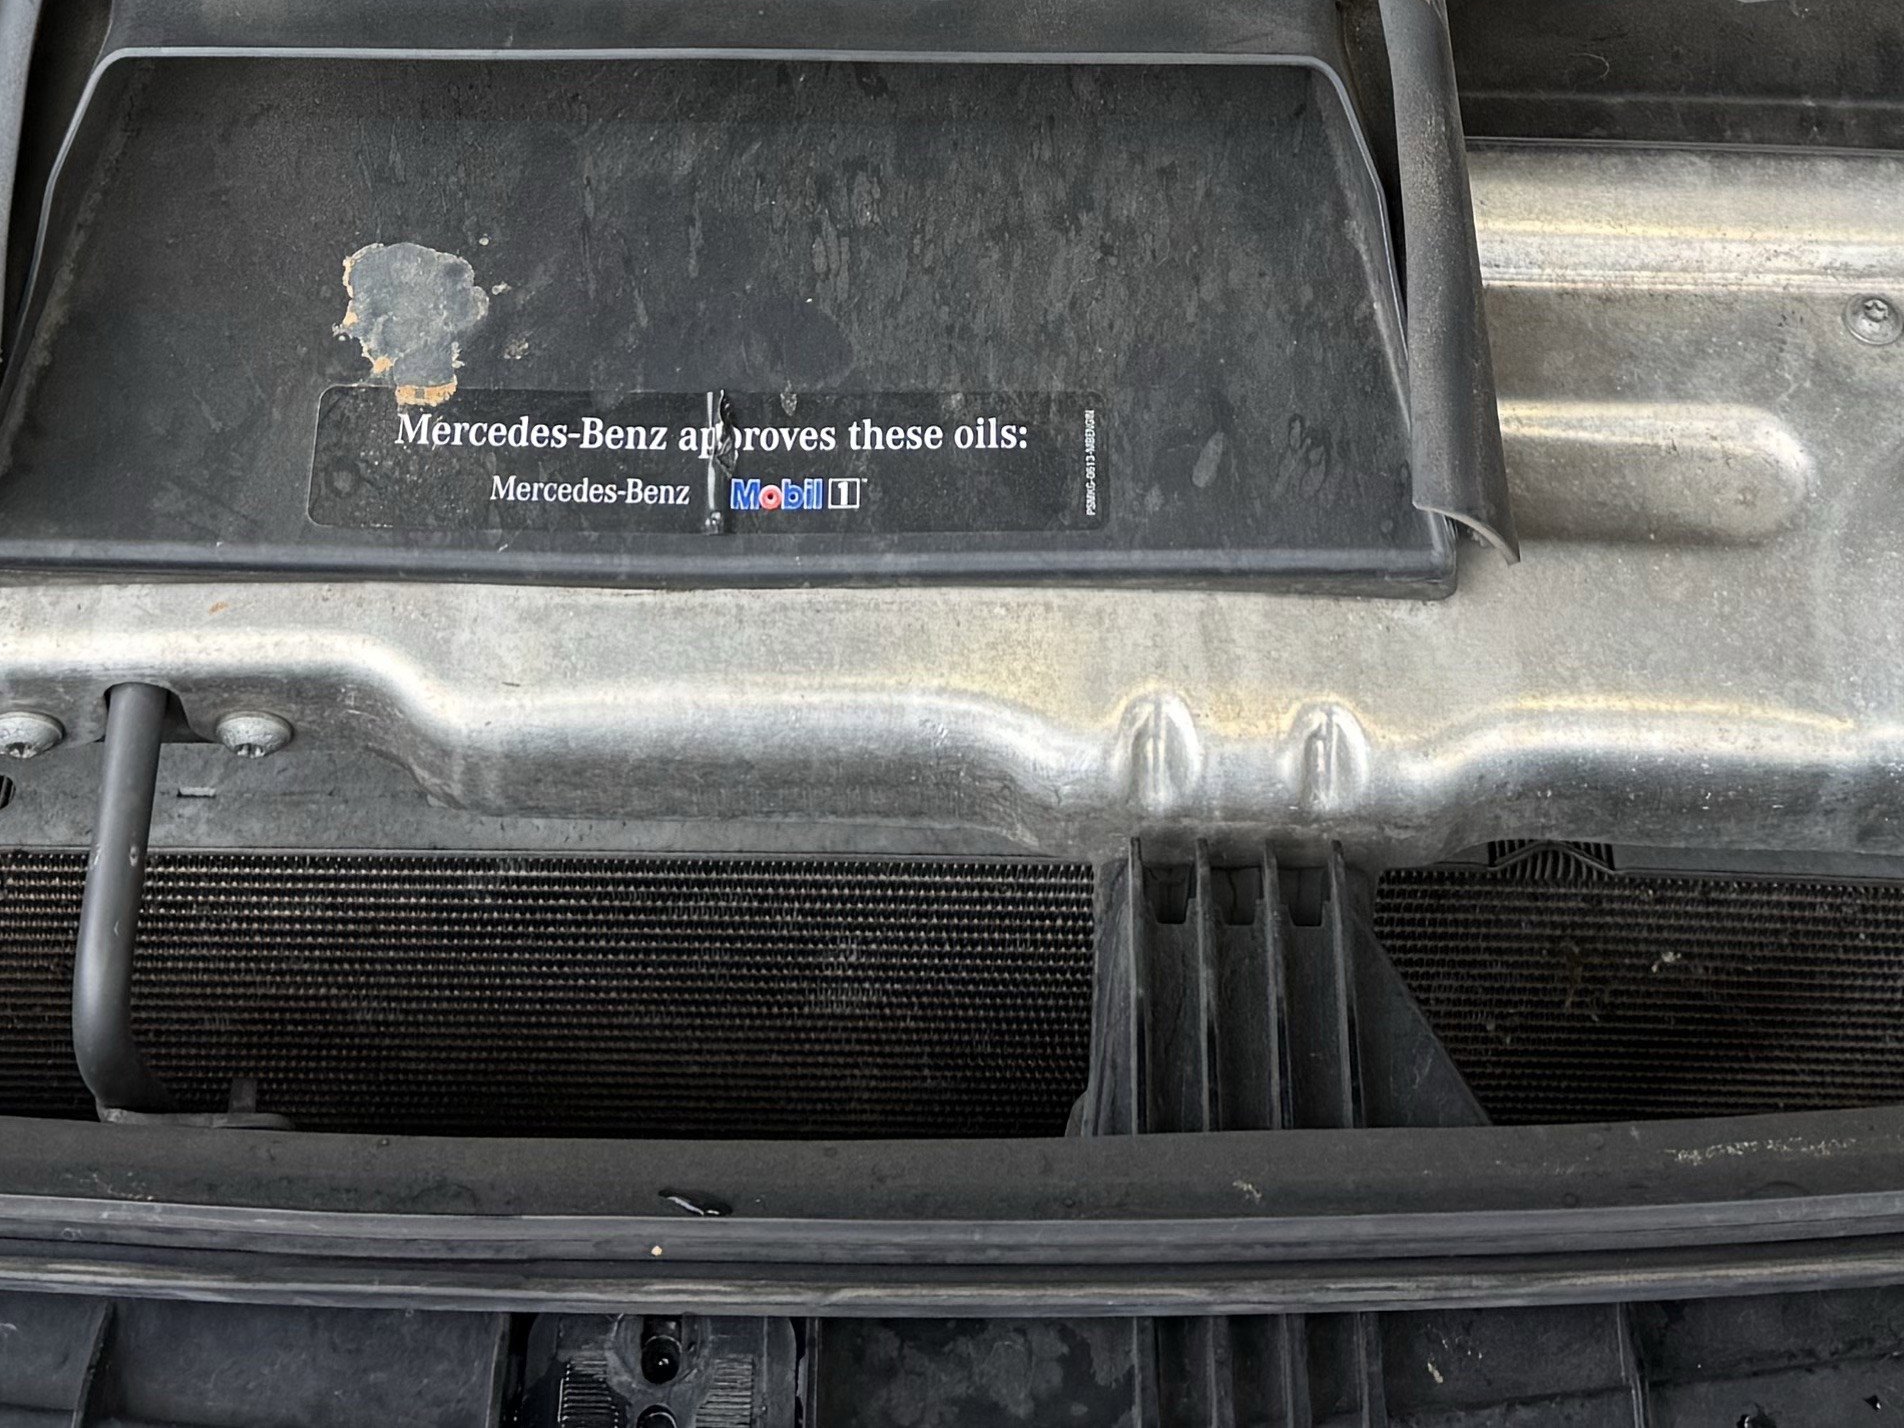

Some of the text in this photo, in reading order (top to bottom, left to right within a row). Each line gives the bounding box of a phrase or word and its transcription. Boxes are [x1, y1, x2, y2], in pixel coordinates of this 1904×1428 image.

[394, 413, 668, 452] Mercedes-Benz
[848, 419, 944, 450] these
[953, 416, 1029, 450] oils:
[490, 475, 691, 506] Mercedes-Benz
[730, 477, 823, 510] Mobil
